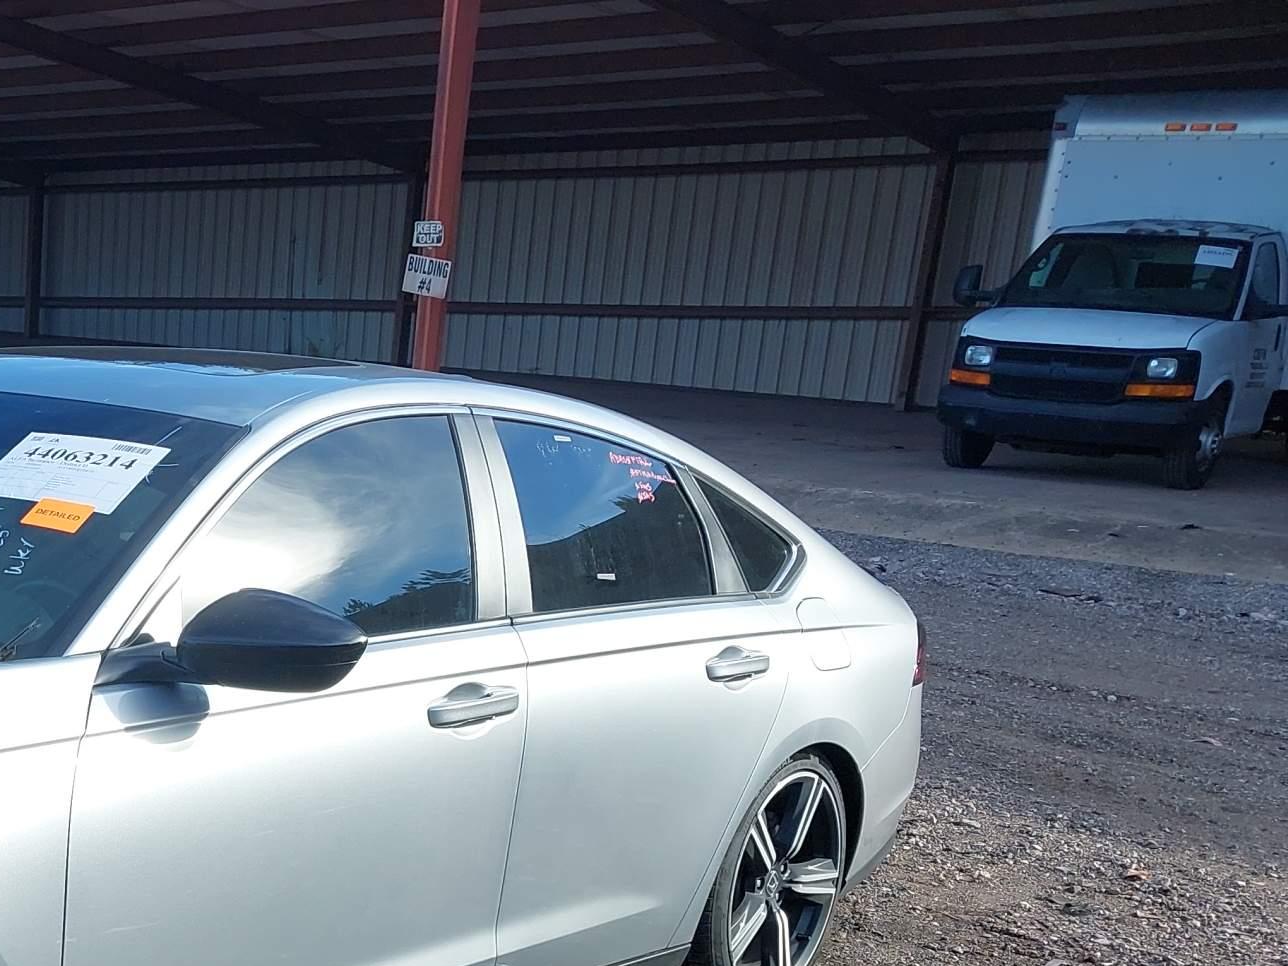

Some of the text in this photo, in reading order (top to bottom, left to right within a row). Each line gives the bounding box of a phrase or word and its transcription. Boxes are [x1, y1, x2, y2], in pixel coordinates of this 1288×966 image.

[417, 223, 443, 234] KEEP
[418, 234, 440, 244] OUT
[408, 256, 450, 279] BUILDING
[417, 277, 432, 294] #4
[24, 445, 138, 470] 44063214
[34, 507, 82, 522] DETAILED
